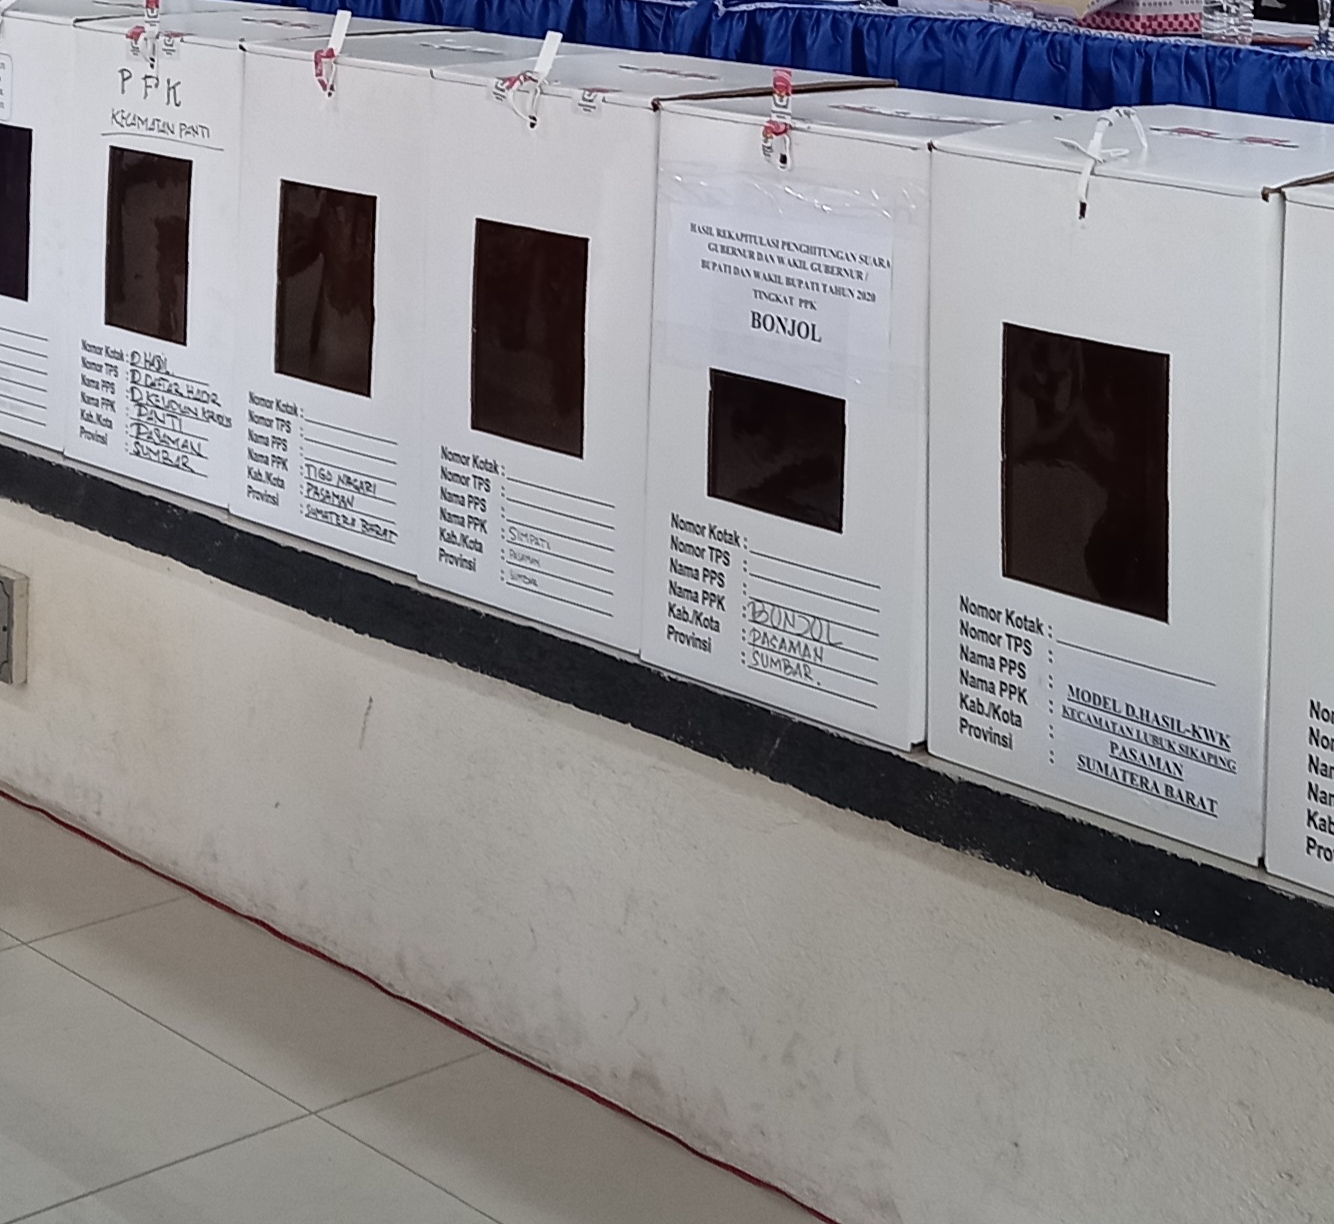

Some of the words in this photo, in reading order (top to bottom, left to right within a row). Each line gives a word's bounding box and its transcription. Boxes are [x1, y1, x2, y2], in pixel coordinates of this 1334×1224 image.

[690, 223, 714, 237] HASIL
[716, 227, 779, 249] REKAPITULASI
[781, 240, 857, 263] PENGHITUNGAN
[858, 254, 891, 269] SUARA
[708, 242, 755, 260] GUBERNUR
[757, 251, 776, 264] DAN
[777, 256, 808, 271] WAKIL
[810, 262, 863, 281] GUBERNUR
[701, 259, 731, 275] BUPATI
[733, 266, 751, 279] DAN
[753, 269, 783, 285] WAKIL
[785, 278, 819, 292] BUPATI
[821, 283, 855, 299] TAHUN
[856, 288, 876, 303] 2020
[752, 288, 794, 306] TINGKAT
[798, 298, 817, 311] PPK
[750, 310, 823, 343] BONJOL
[440, 446, 470, 466] Nomor
[472, 454, 499, 476] Kotak
[440, 466, 470, 488] Nomor
[472, 475, 491, 493] TPS
[440, 486, 466, 507] Nama
[467, 494, 487, 513] PPS
[439, 507, 466, 527] Nama
[467, 515, 488, 535] PPK
[671, 512, 706, 538] Nomor
[708, 523, 742, 549] Kotak
[439, 527, 483, 554] Kab./Kota
[670, 535, 706, 560] Nomor
[708, 545, 731, 567] TPS
[438, 547, 477, 572] Provinsi
[669, 557, 700, 582] Nama
[702, 567, 725, 588] PPS
[669, 579, 699, 604] Nama
[701, 589, 726, 612] PPK
[667, 601, 721, 633] Kab./Kota
[959, 595, 1003, 624] Nomor
[1005, 608, 1045, 637] Kotak
[666, 624, 712, 653] Provinsi
[959, 619, 1002, 649] Nomor
[1005, 633, 1033, 657] TPS
[959, 644, 996, 670] Nama
[998, 656, 1027, 680] PPS
[959, 668, 996, 695] Nama
[998, 681, 1028, 706] PPK
[959, 692, 1023, 729] Kab./Kota
[1062, 704, 1133, 738] KECAMATAN
[1067, 684, 1121, 714] MODEL
[1124, 701, 1231, 751] D.HASIL-KWK
[959, 717, 1013, 751] Provinsi
[1109, 740, 1184, 777] PASAMAN
[1077, 754, 1161, 794] SUMATERA
[1163, 782, 1219, 814] BARAT
